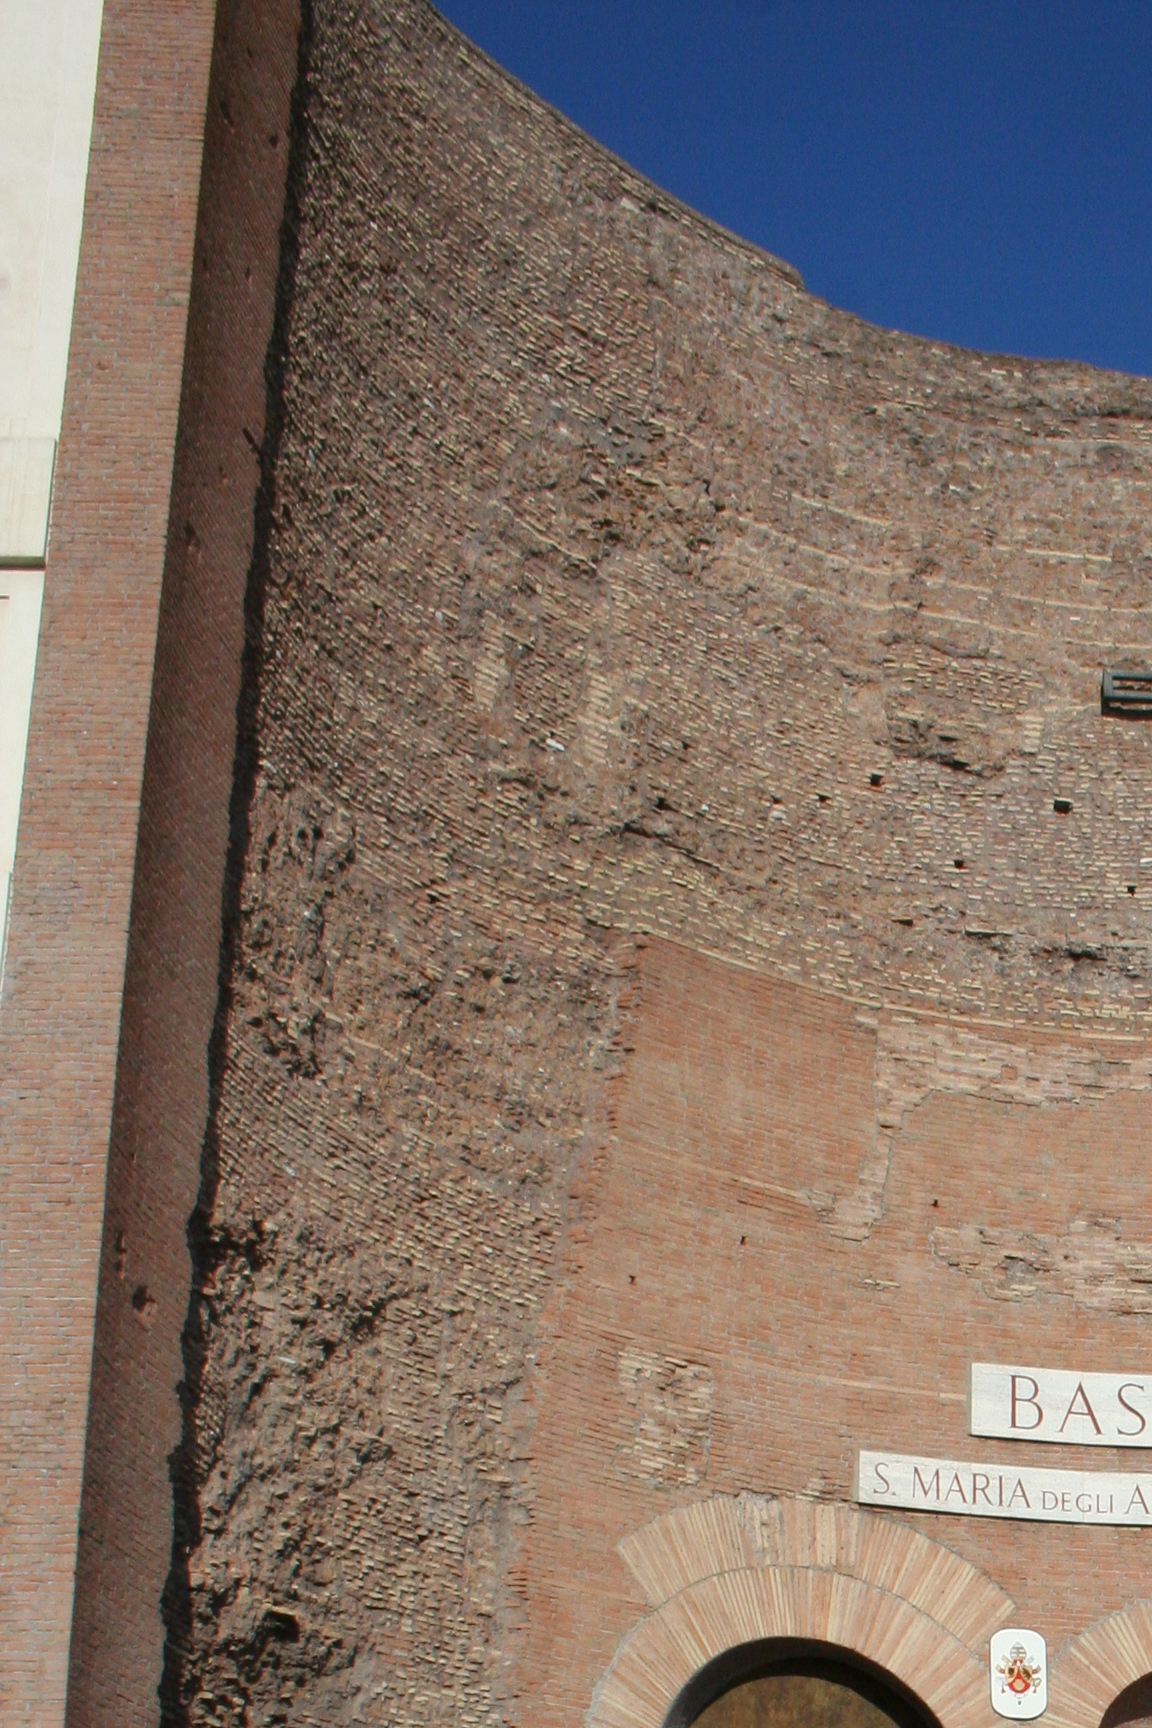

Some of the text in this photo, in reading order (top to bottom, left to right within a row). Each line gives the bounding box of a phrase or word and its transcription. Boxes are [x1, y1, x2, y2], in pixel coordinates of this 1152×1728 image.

[872, 1461, 897, 1496] S.
[911, 1466, 1032, 1510] MARIA
[1041, 1490, 1114, 1515] DEGLI
